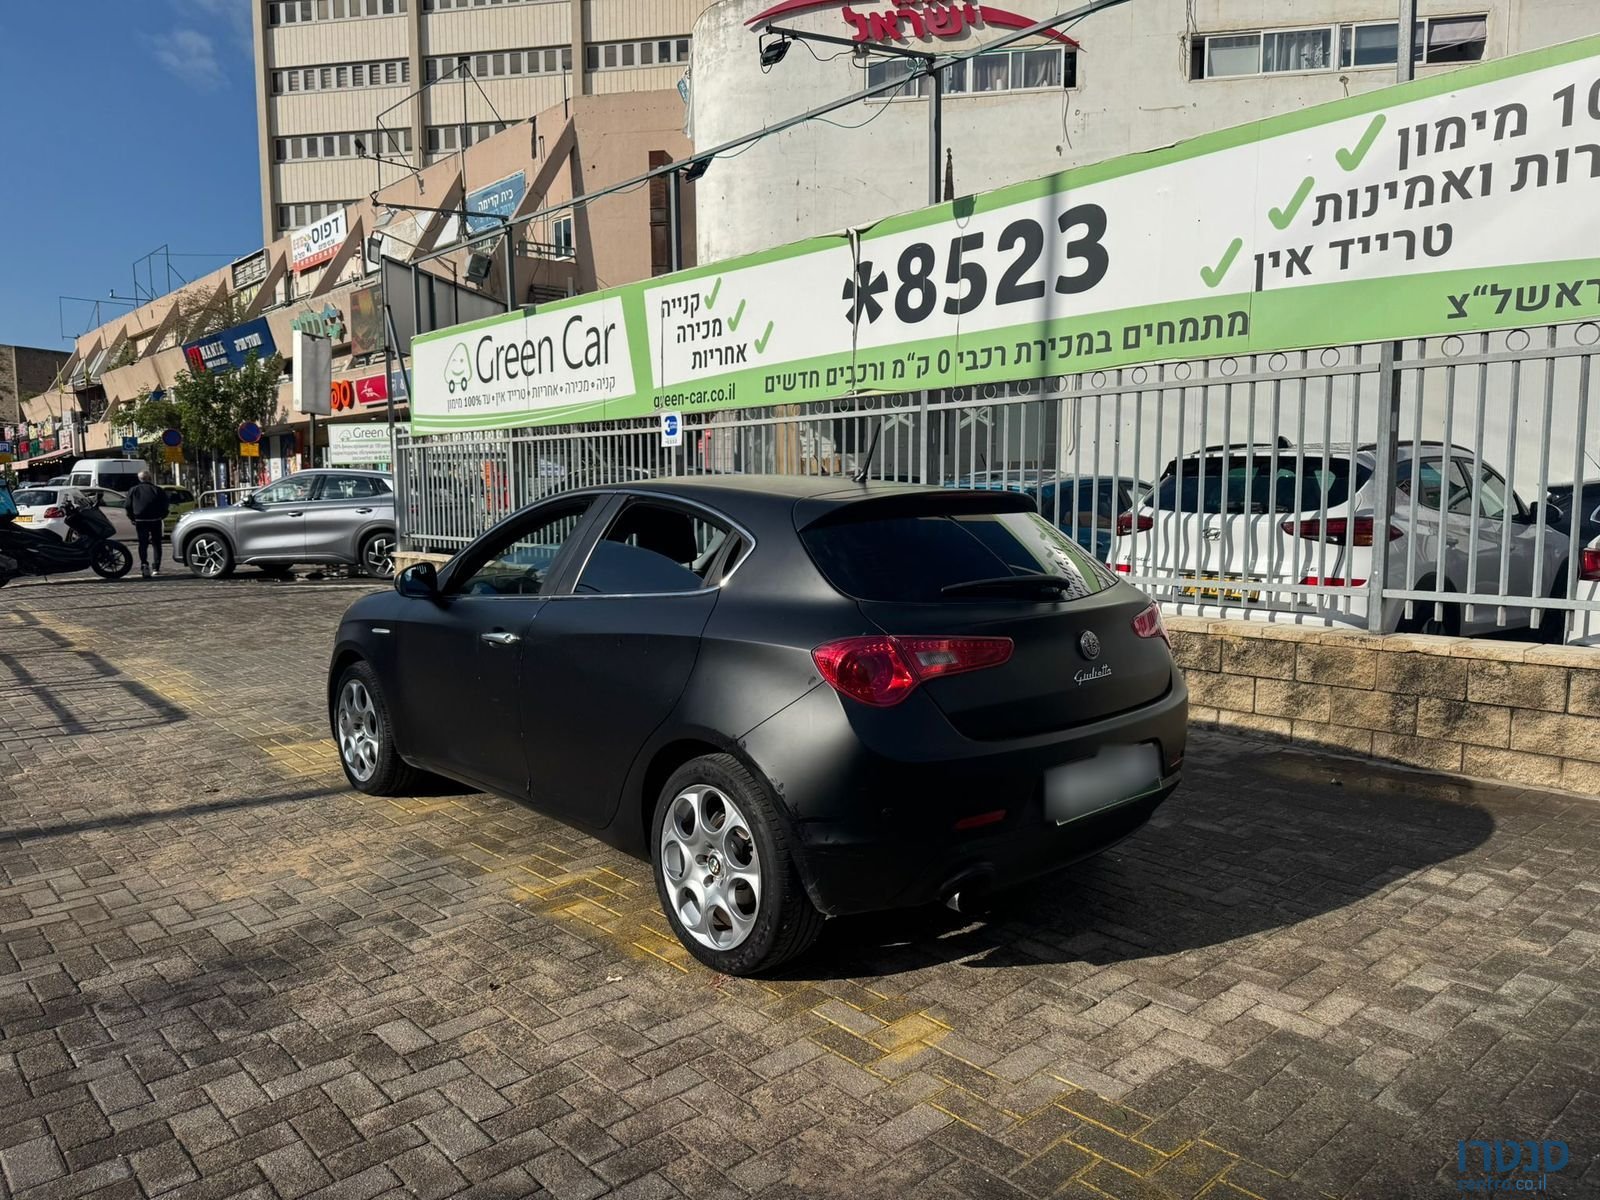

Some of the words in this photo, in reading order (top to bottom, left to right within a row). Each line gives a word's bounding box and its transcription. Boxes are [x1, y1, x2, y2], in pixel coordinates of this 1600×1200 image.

[842, 4, 977, 42] ישראל
[1398, 103, 1528, 171] מימון
[1312, 163, 1493, 227] ואמינות
[312, 217, 339, 244] דפוס
[1329, 222, 1453, 271] טרייד
[1254, 245, 1314, 292] אין
[661, 293, 700, 318] קנייה
[677, 318, 722, 343] מכירה
[1123, 310, 1249, 350] מתמחים
[476, 335, 554, 384] Green
[562, 315, 616, 370] Car
[692, 343, 747, 370] אחריות
[957, 345, 1006, 371] רכבי
[1014, 329, 1113, 365] במכירת
[596, 376, 616, 393] קניה
[765, 369, 820, 393] חדשים
[826, 361, 885, 386] ורכבים
[507, 388, 527, 400] טרייד
[531, 383, 559, 399] אחריות
[564, 379, 590, 394] מכירה
[653, 382, 736, 408] geen-car.co.il
[447, 398, 463, 412] מימון
[464, 395, 482, 408] 100%
[353, 427, 384, 438] Green
[1074, 664, 1112, 685] Giulietta
